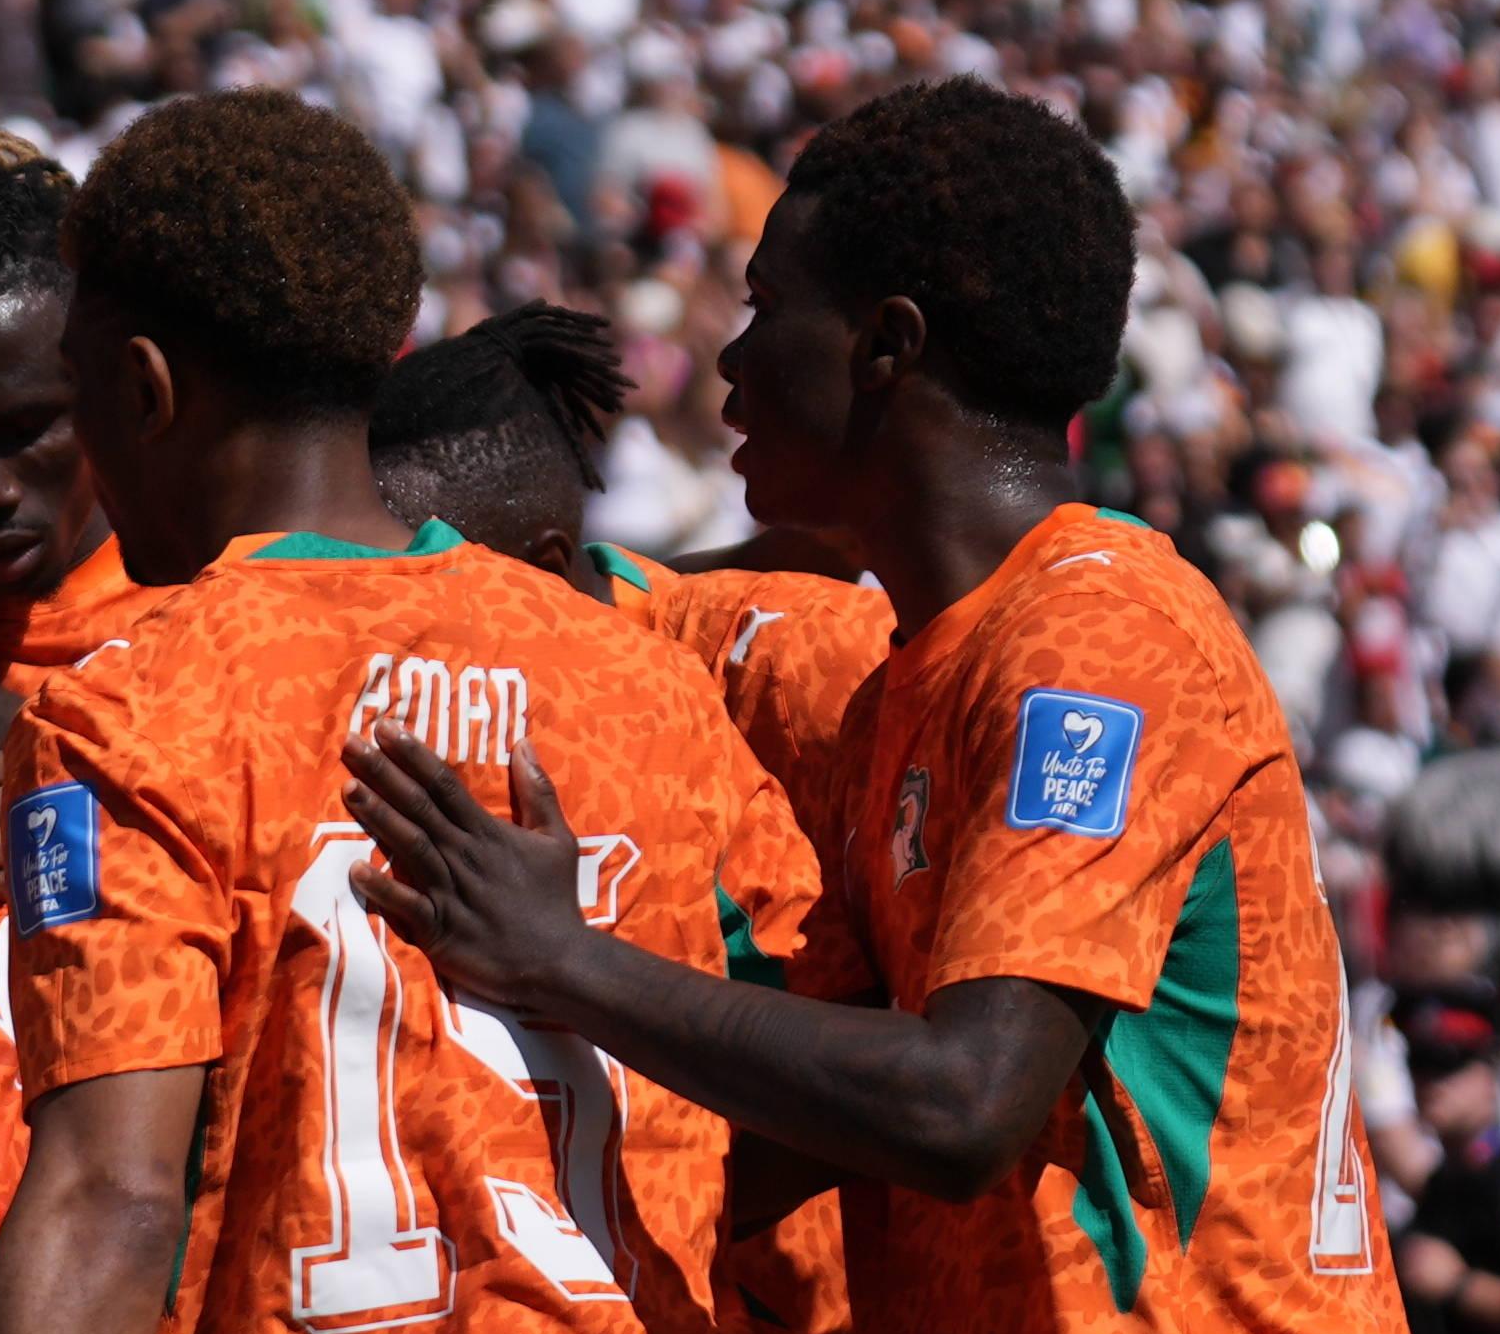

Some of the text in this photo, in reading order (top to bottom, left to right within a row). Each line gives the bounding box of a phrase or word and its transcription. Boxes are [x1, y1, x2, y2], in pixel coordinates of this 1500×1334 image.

[349, 653, 529, 767] AMAD
[1041, 750, 1085, 778] Unite
[1042, 777, 1098, 806] PEACE
[1049, 802, 1079, 818] FIFA
[25, 868, 70, 903] PEACE
[34, 898, 61, 915] FIFA
